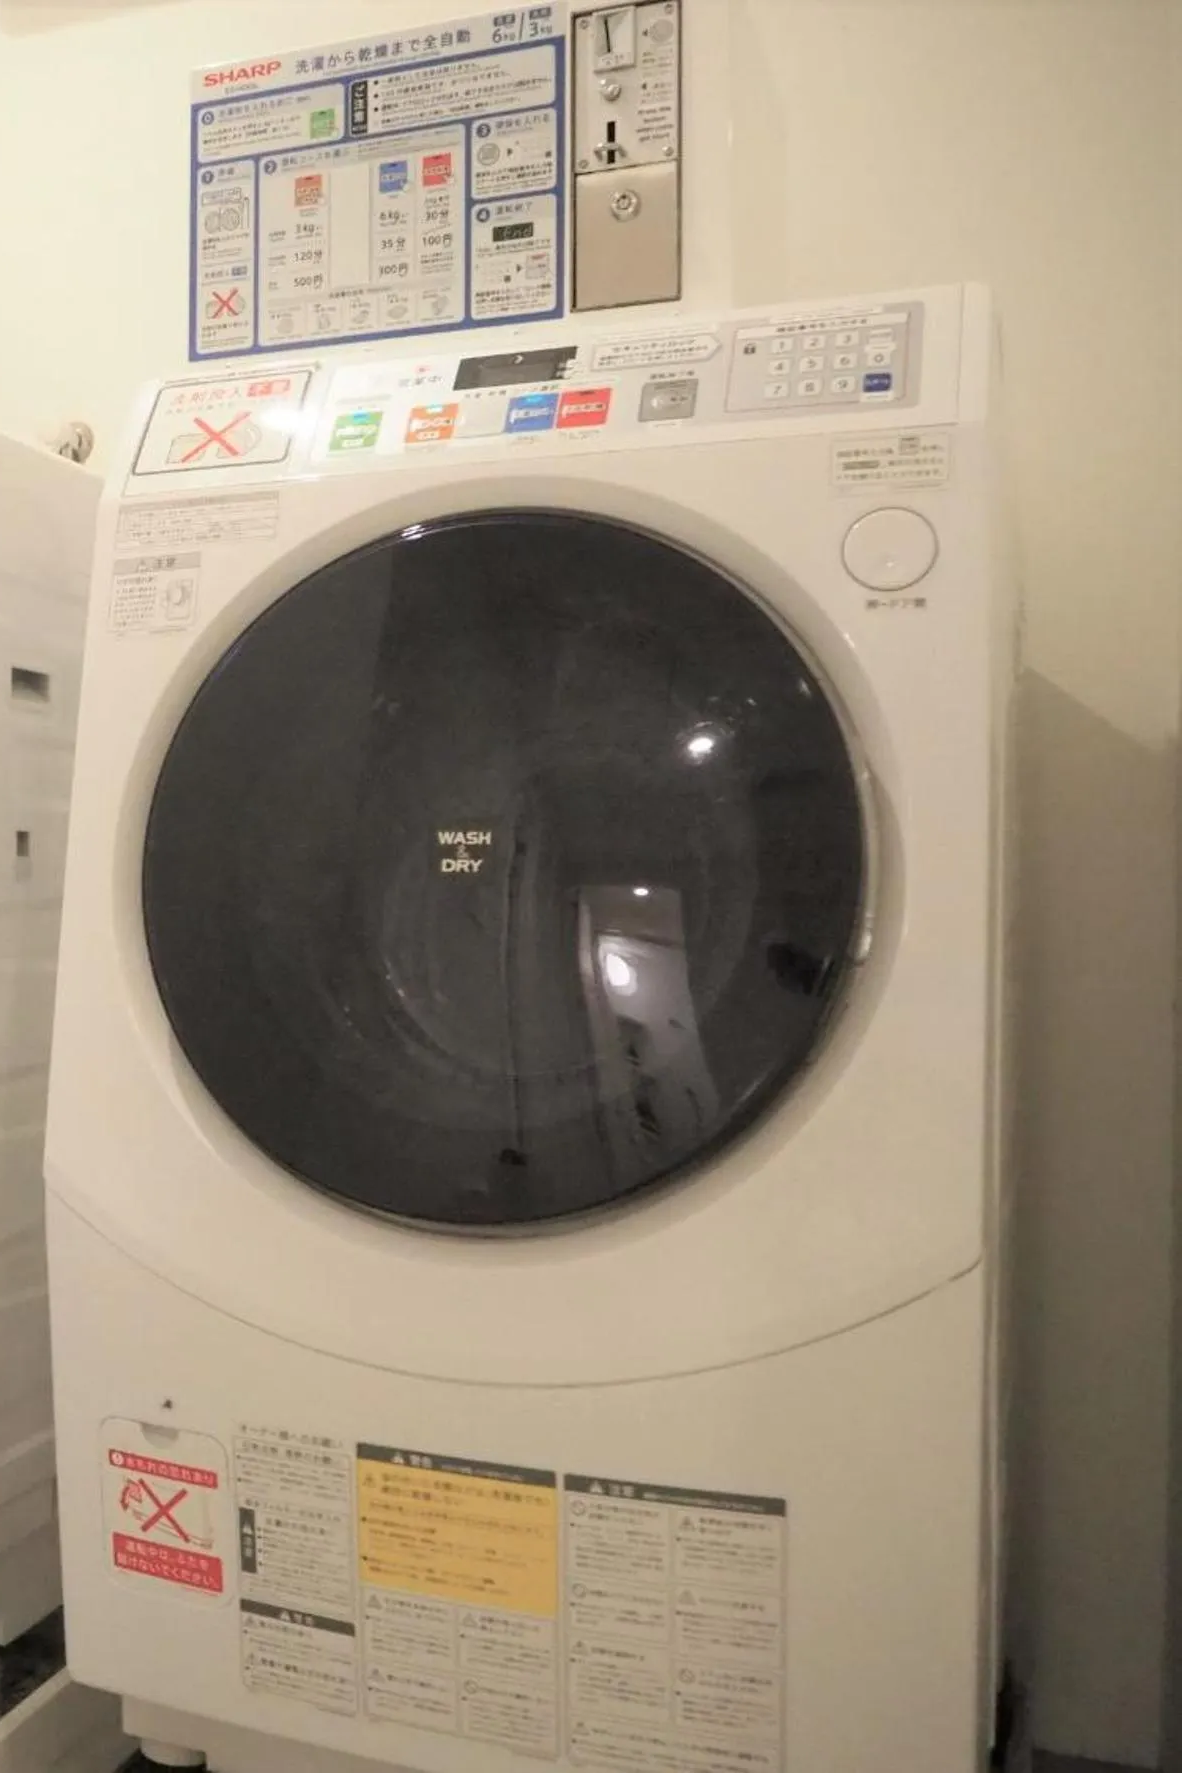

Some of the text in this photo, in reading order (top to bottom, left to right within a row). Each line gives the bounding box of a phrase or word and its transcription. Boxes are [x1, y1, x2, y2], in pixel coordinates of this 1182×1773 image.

[203, 60, 282, 87] SHARP
[438, 831, 492, 845] WASH
[441, 858, 484, 873] DRY
